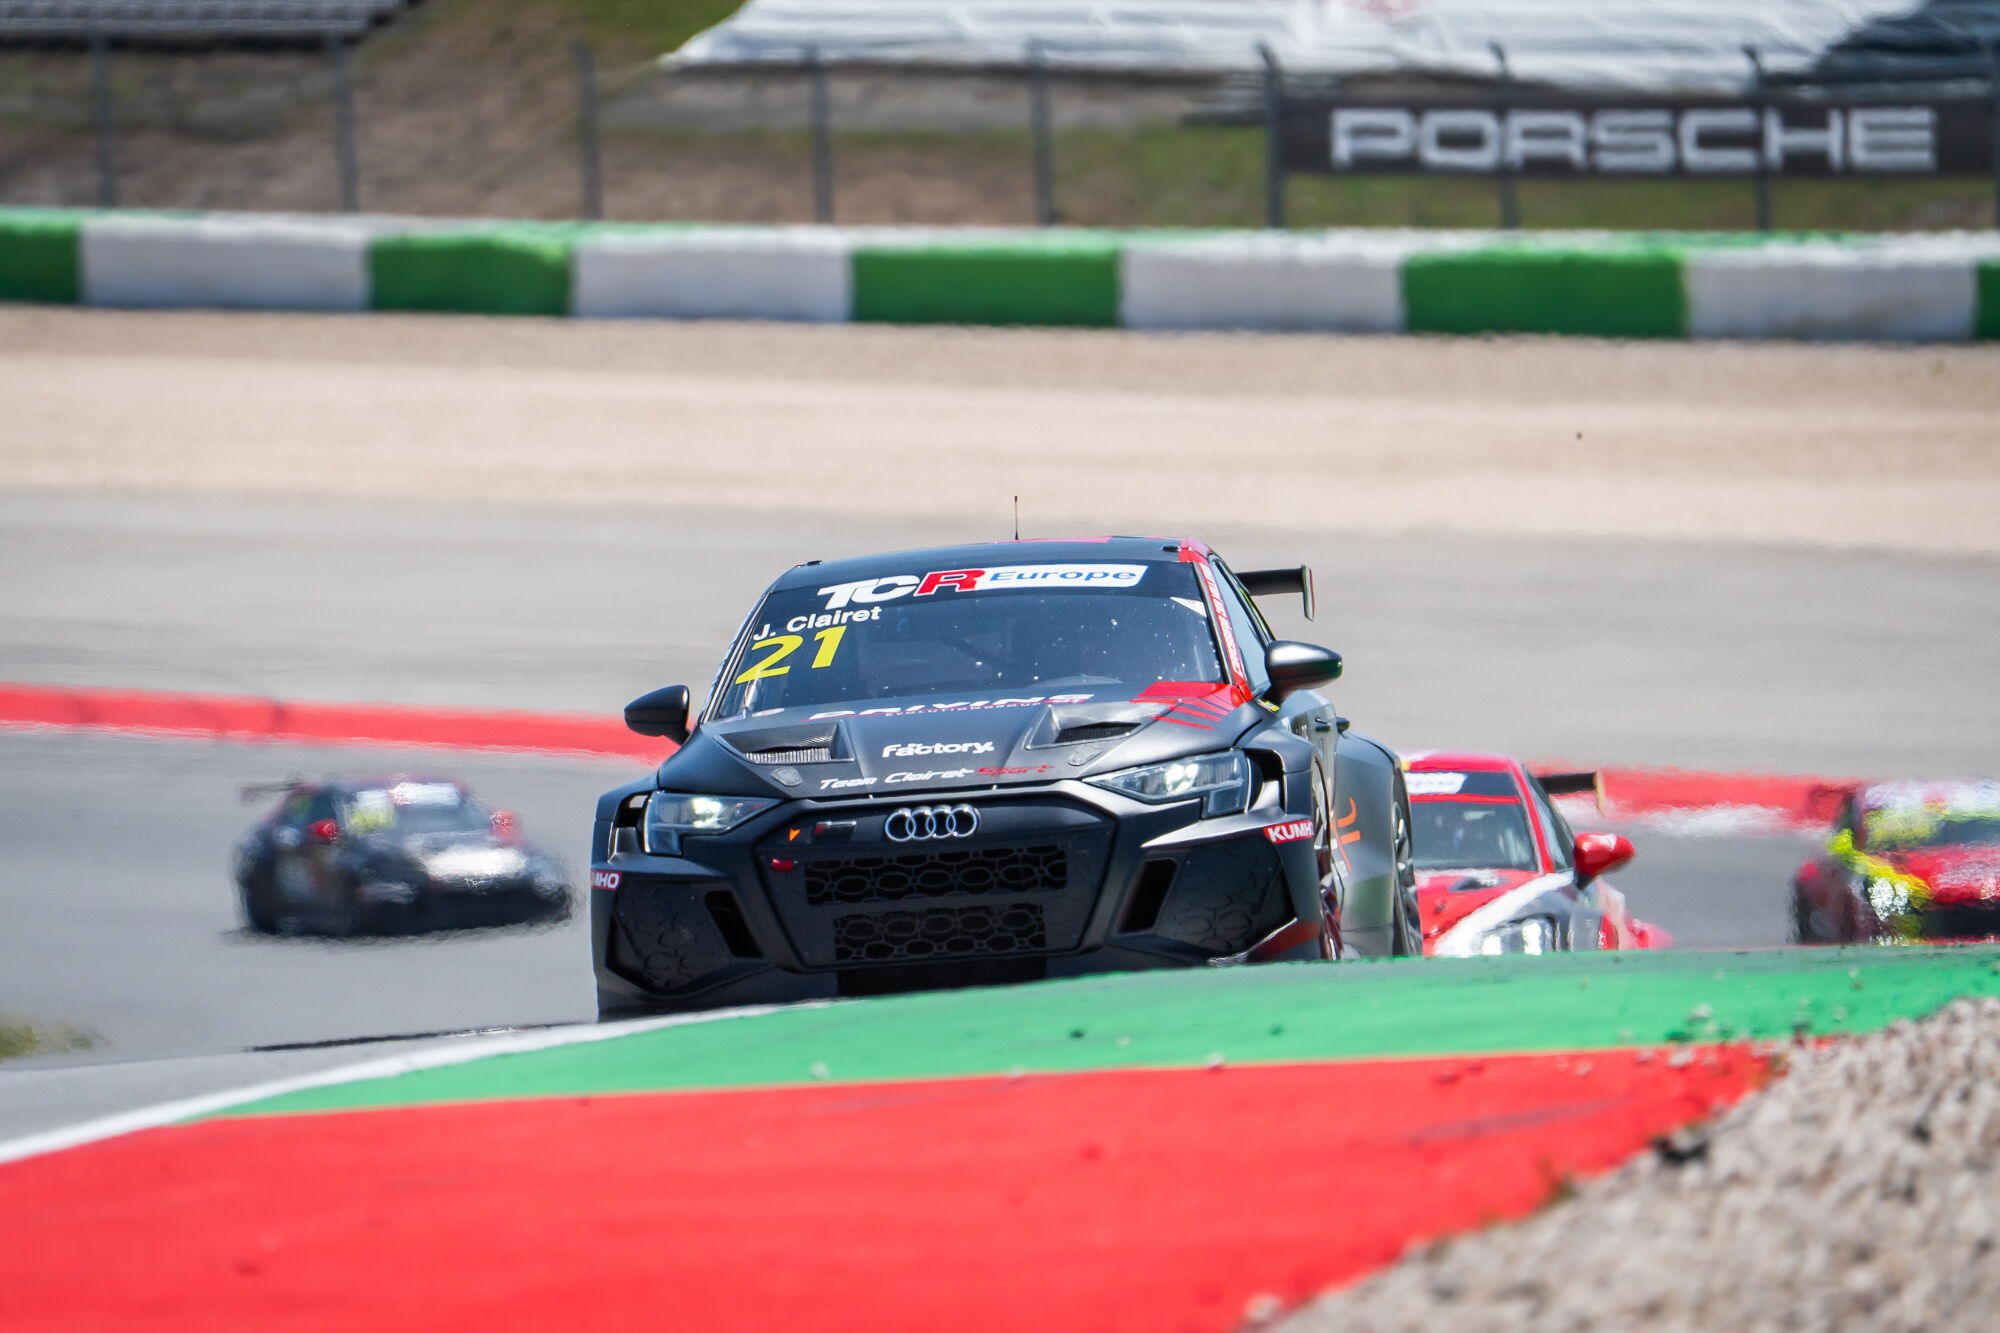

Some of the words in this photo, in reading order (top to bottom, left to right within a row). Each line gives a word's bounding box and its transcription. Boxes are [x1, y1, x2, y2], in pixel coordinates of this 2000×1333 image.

[1331, 107, 1937, 171] PORSCHE
[817, 569, 986, 610] TCR
[989, 571, 1136, 582] Europe
[753, 624, 776, 641] J.
[786, 606, 882, 632] Clairet
[735, 625, 847, 684] 21
[819, 778, 877, 790] Team
[884, 768, 974, 784] Clairet
[977, 764, 1055, 777] Sport
